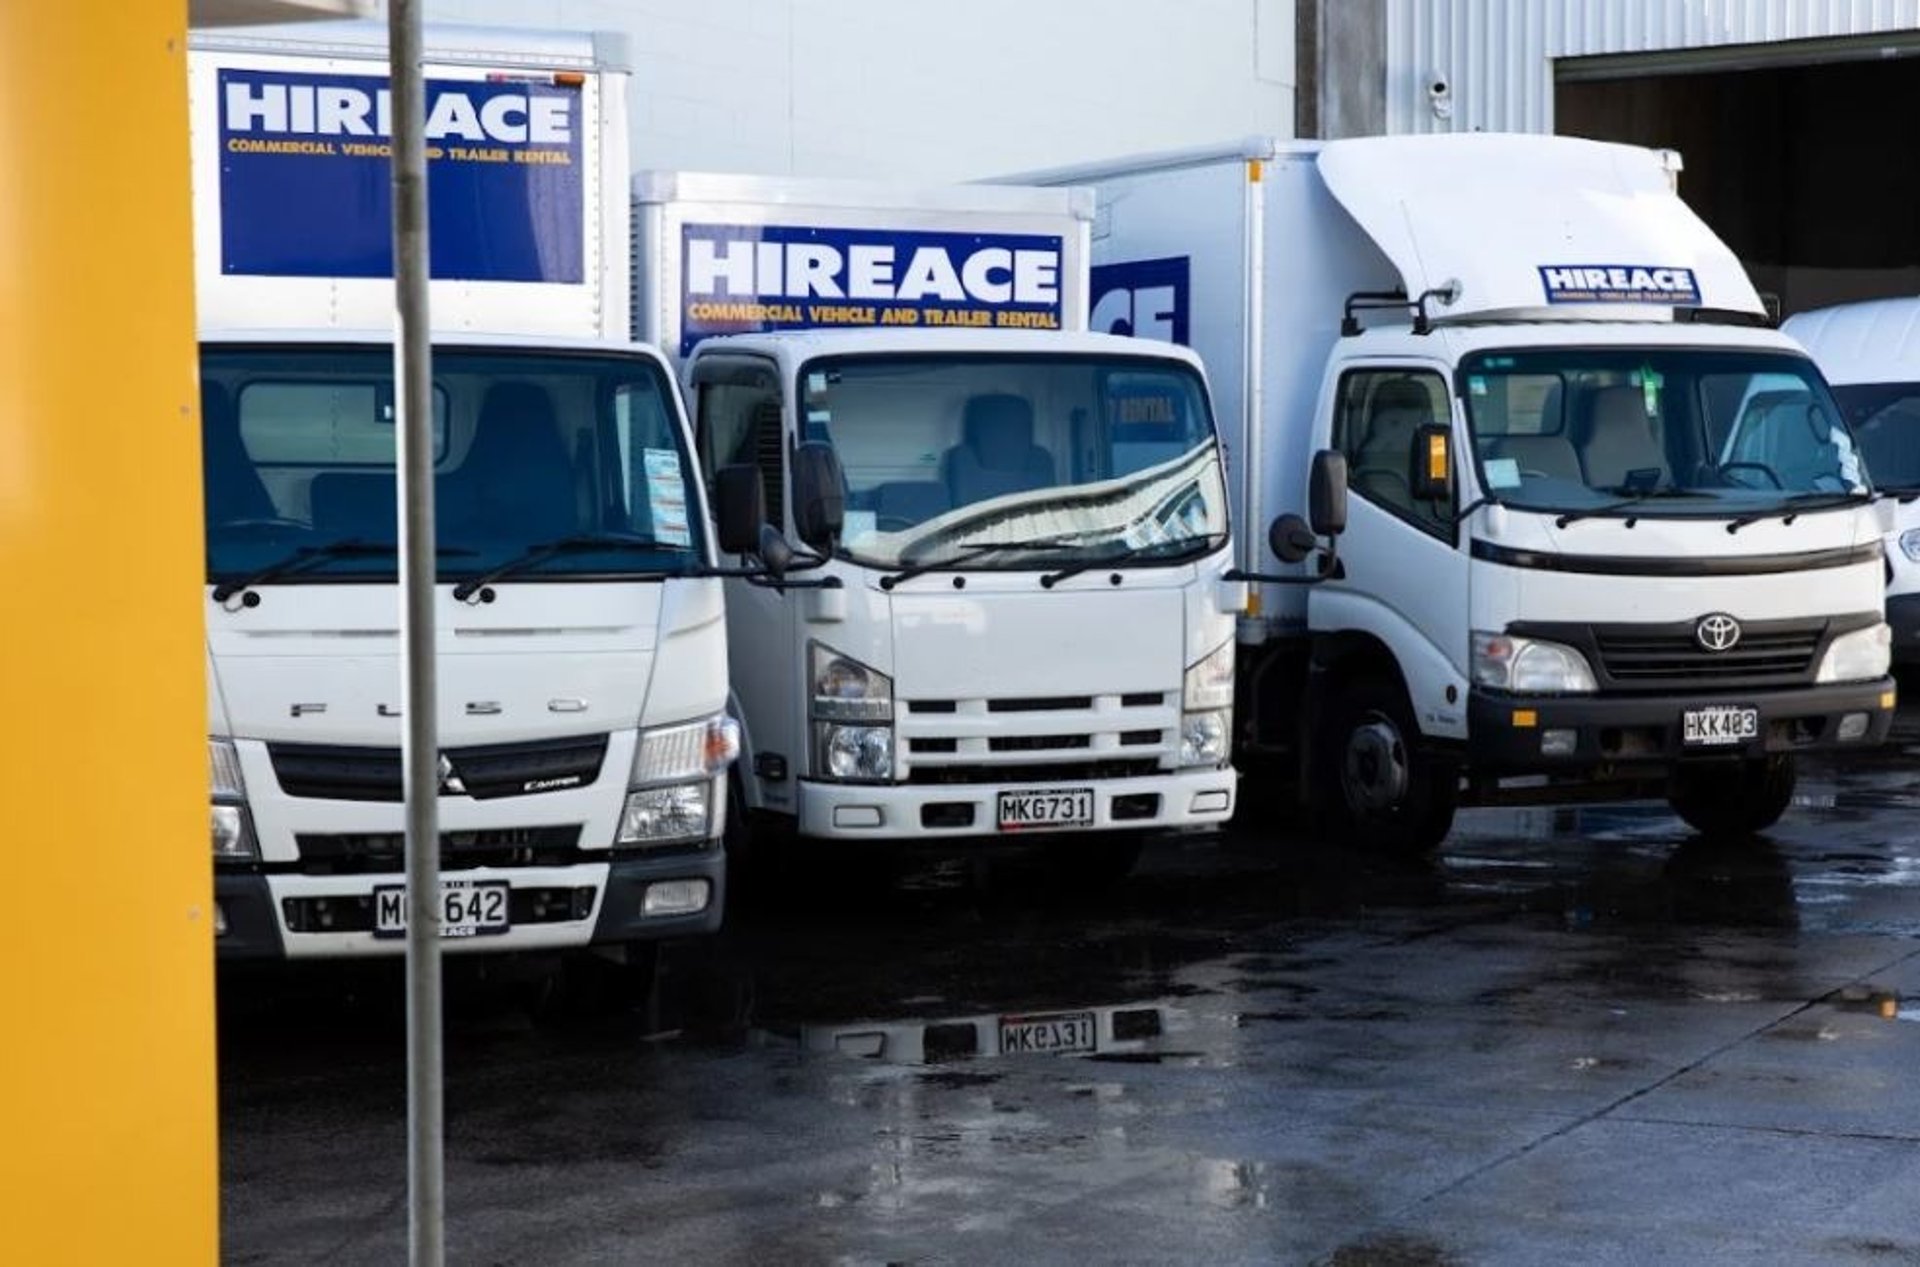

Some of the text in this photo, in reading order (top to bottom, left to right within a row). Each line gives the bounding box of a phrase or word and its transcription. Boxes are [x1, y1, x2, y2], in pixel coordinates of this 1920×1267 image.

[228, 138, 336, 154] COMMERCIAL
[342, 144, 393, 157] VEHIC
[449, 147, 508, 162] TRAILER
[513, 150, 571, 165] RENTAL
[689, 239, 1058, 303] HIREACE
[1543, 268, 1693, 291] HIREACE
[689, 303, 1058, 327] COMMERCIAL VEHICLE AND TRAILER RENTAL
[1003, 797, 1085, 820] MKG731
[381, 891, 502, 925] M642
